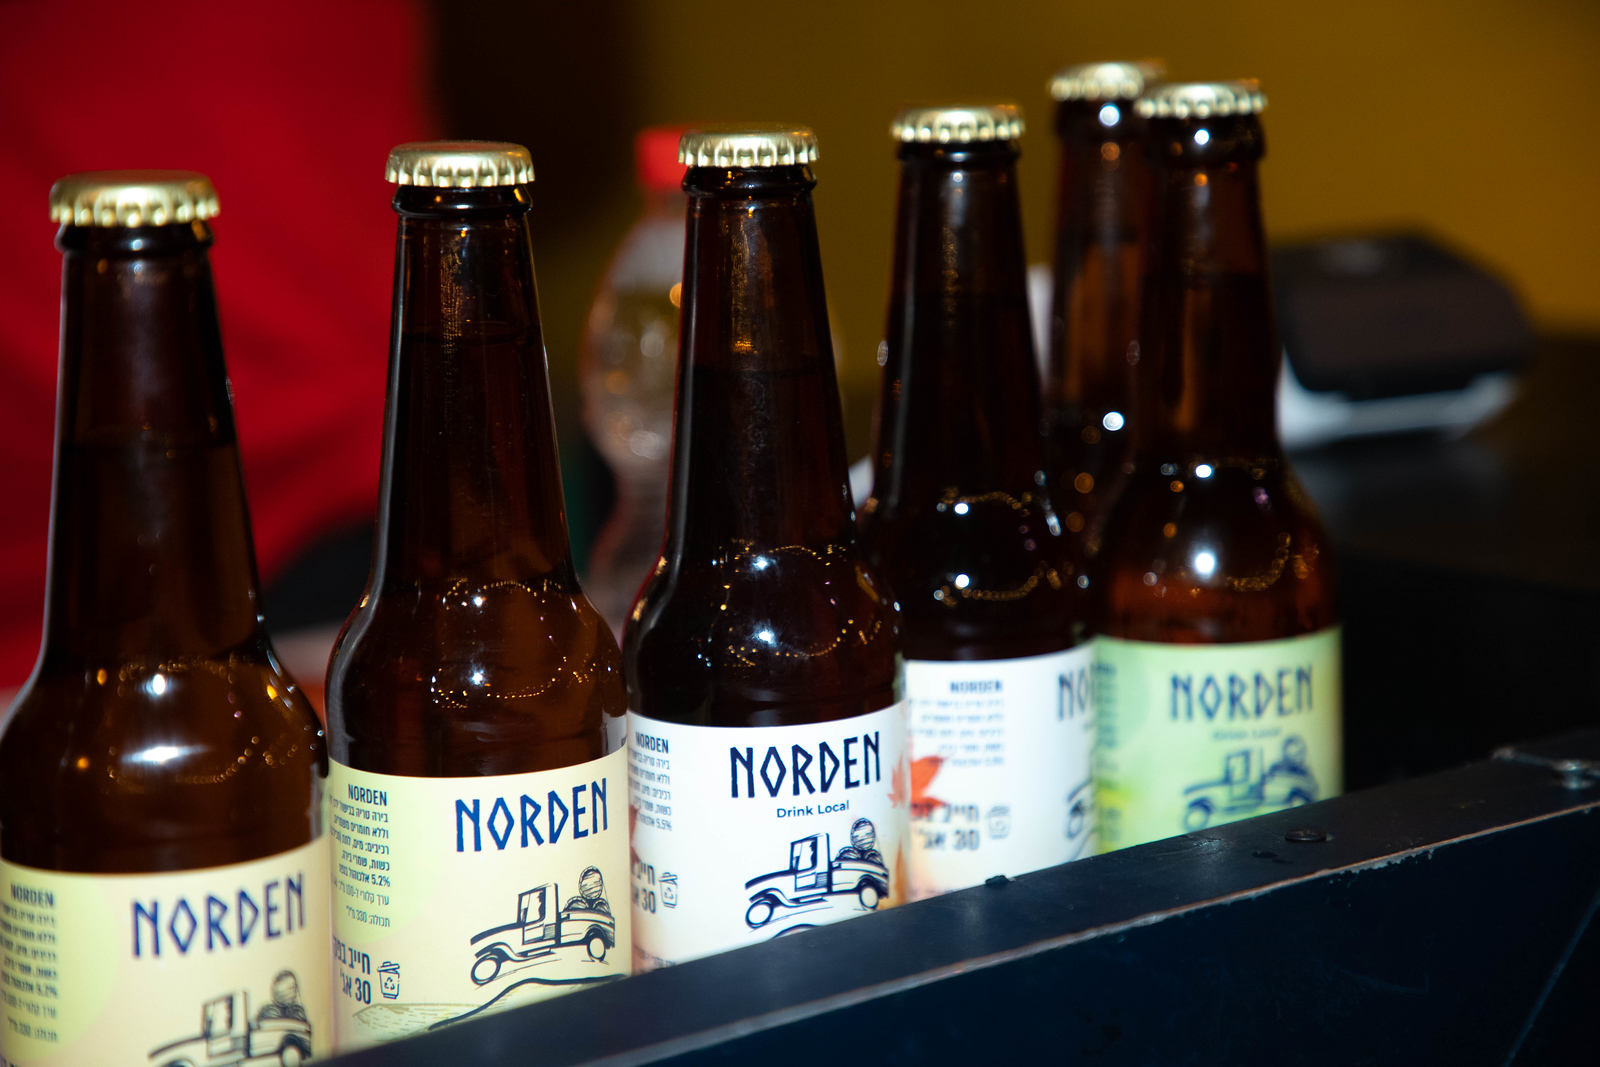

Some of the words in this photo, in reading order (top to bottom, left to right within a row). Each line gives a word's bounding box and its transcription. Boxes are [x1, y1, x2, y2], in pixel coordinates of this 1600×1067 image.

[1058, 664, 1094, 720] NO
[1171, 665, 1313, 721] NORDEN
[635, 731, 669, 754] NORDEN
[730, 731, 880, 798] NORDEN
[348, 784, 388, 806] NORDEN
[371, 812, 388, 823] בירה
[455, 778, 607, 852] NORDEN
[777, 805, 813, 818] Drink
[818, 800, 849, 814] Local
[372, 827, 389, 839] וללא
[953, 829, 979, 850] 30
[371, 874, 390, 887] 5.2%
[11, 884, 55, 908] NORDEN
[641, 887, 656, 914] 30
[131, 873, 304, 959] NORDEN
[356, 909, 367, 923] 330
[348, 947, 370, 975] חייב
[355, 977, 371, 1005] 30
